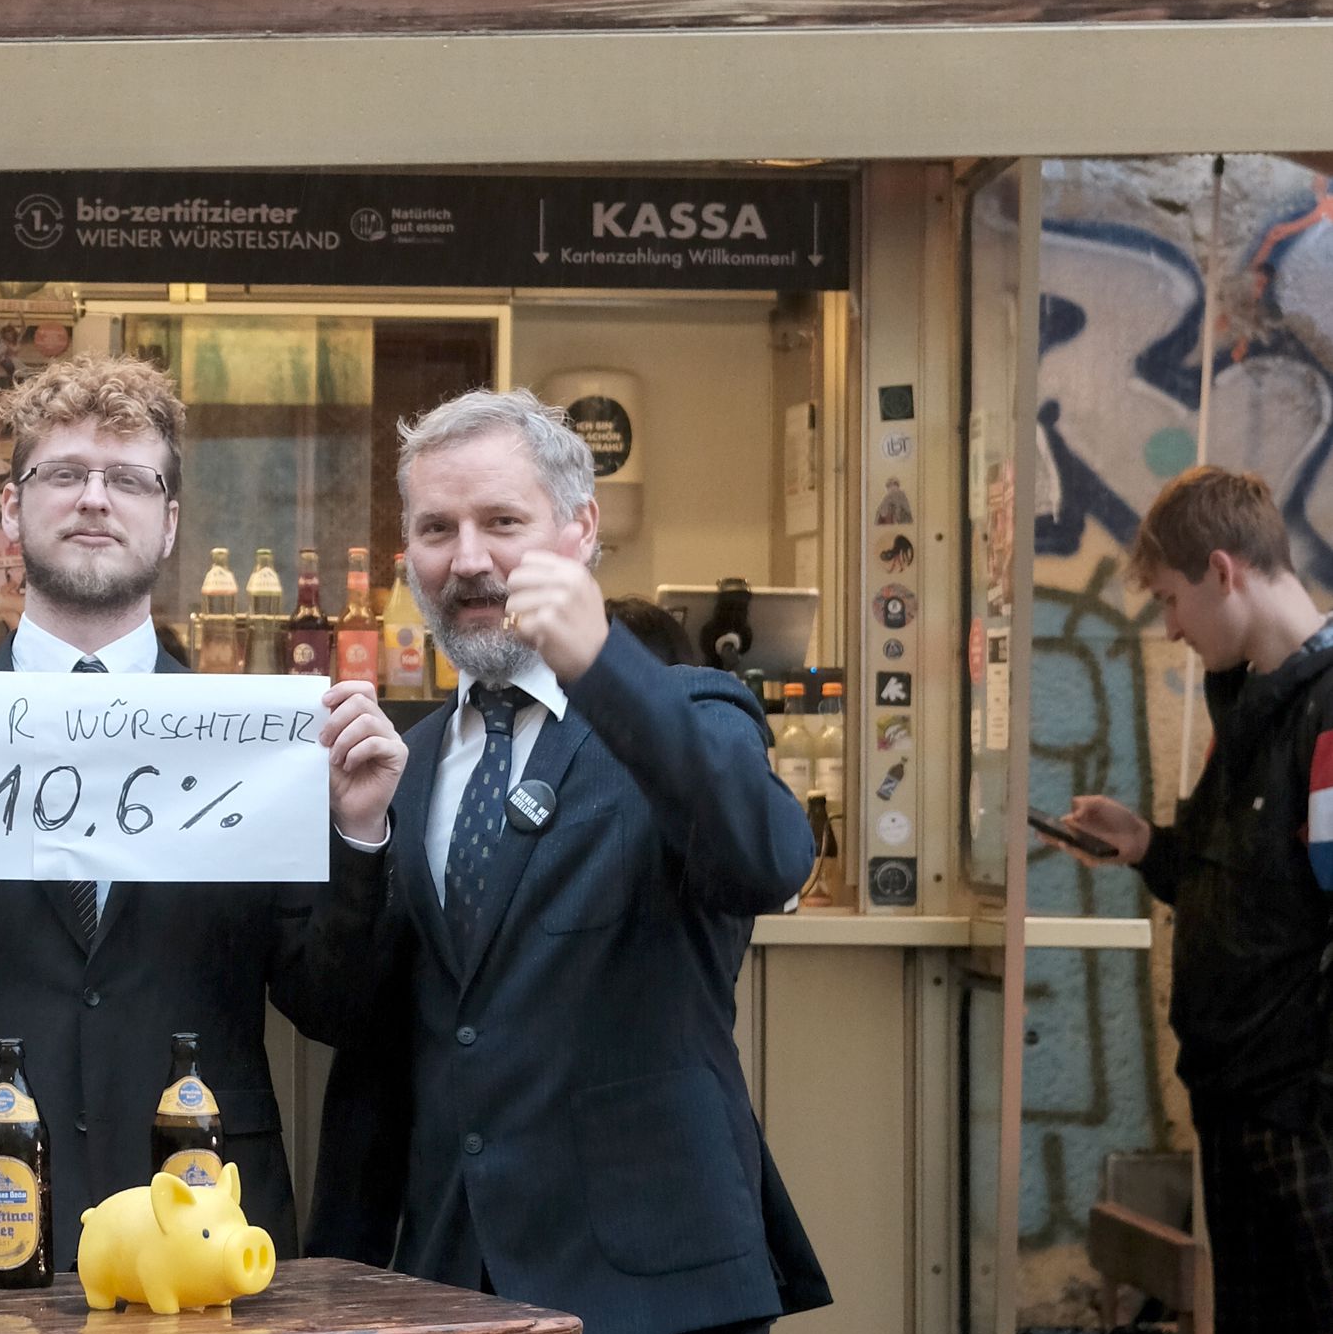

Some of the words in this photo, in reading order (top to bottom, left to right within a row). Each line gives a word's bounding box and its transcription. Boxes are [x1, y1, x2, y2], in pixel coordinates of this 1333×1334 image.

[75, 197, 299, 224] bio-zertifizierter
[592, 201, 767, 240] KASSA
[75, 229, 162, 248] WIENER
[168, 224, 341, 250] WÜRSTELSTAND
[391, 222, 413, 234] gut
[560, 247, 682, 269] Kartenzahlung
[688, 249, 797, 266] Willkommen!
